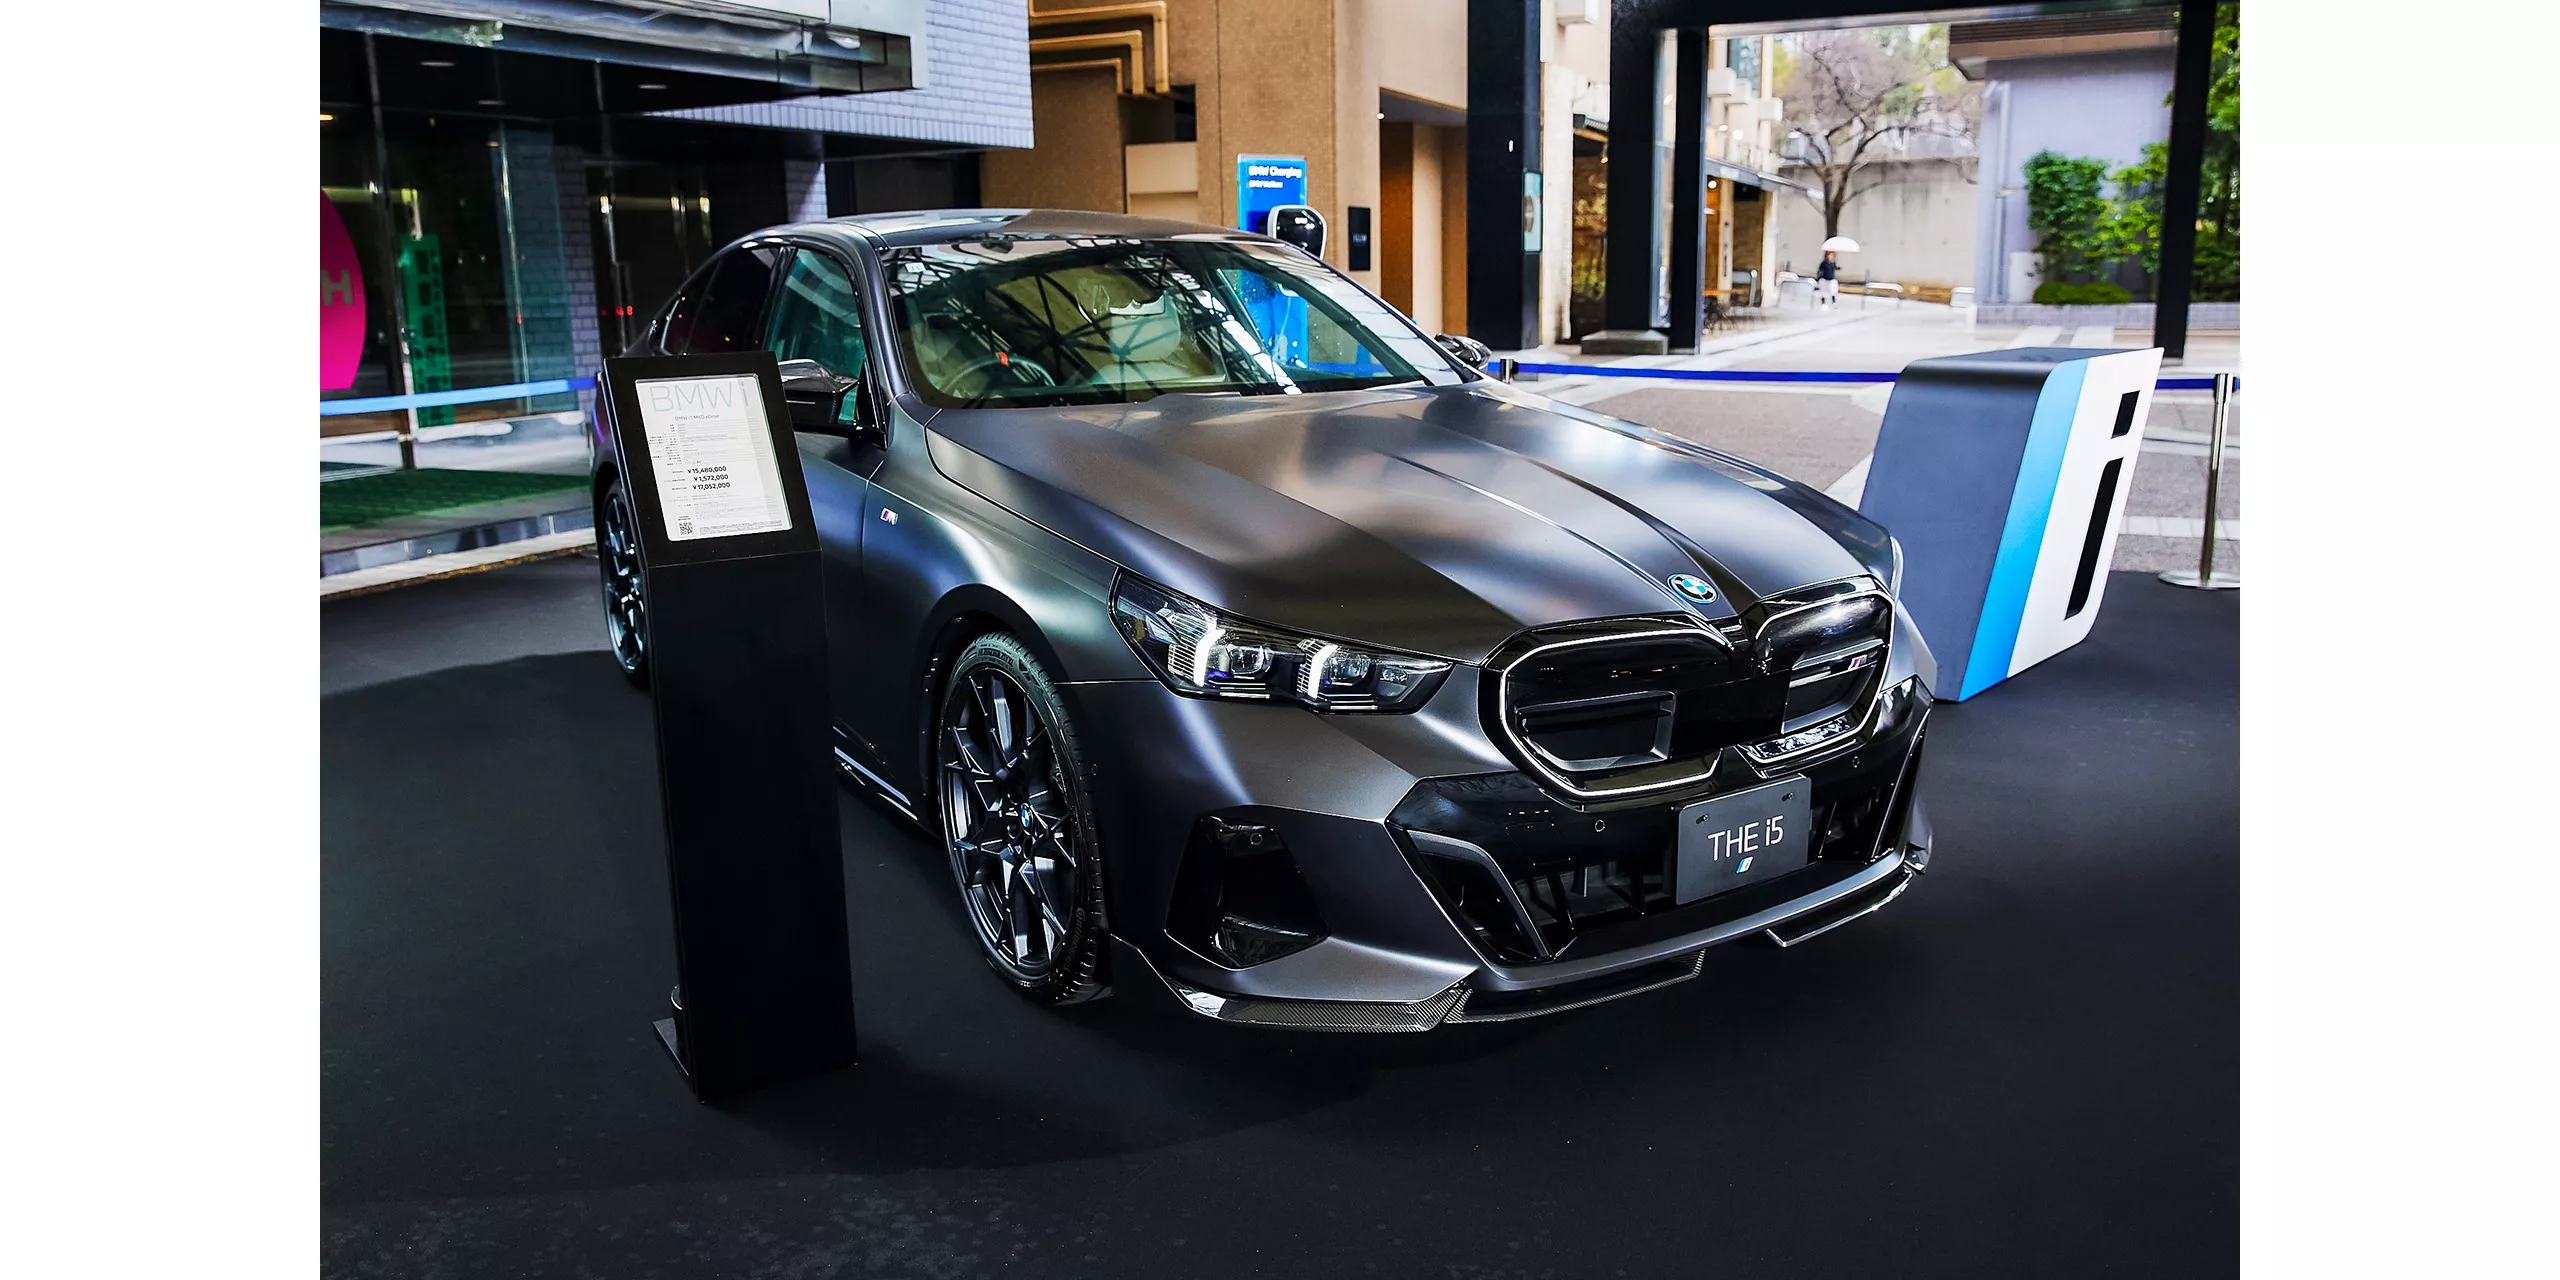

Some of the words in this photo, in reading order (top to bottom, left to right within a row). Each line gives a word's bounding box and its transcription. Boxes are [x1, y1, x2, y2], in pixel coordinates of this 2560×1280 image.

[1270, 166, 1302, 178] Charging
[320, 269, 354, 306] H
[649, 383, 732, 412] BMW
[740, 380, 749, 406] i
[2063, 390, 2140, 620] i
[1707, 822, 1759, 861] THE
[1765, 815, 1784, 846] i5
